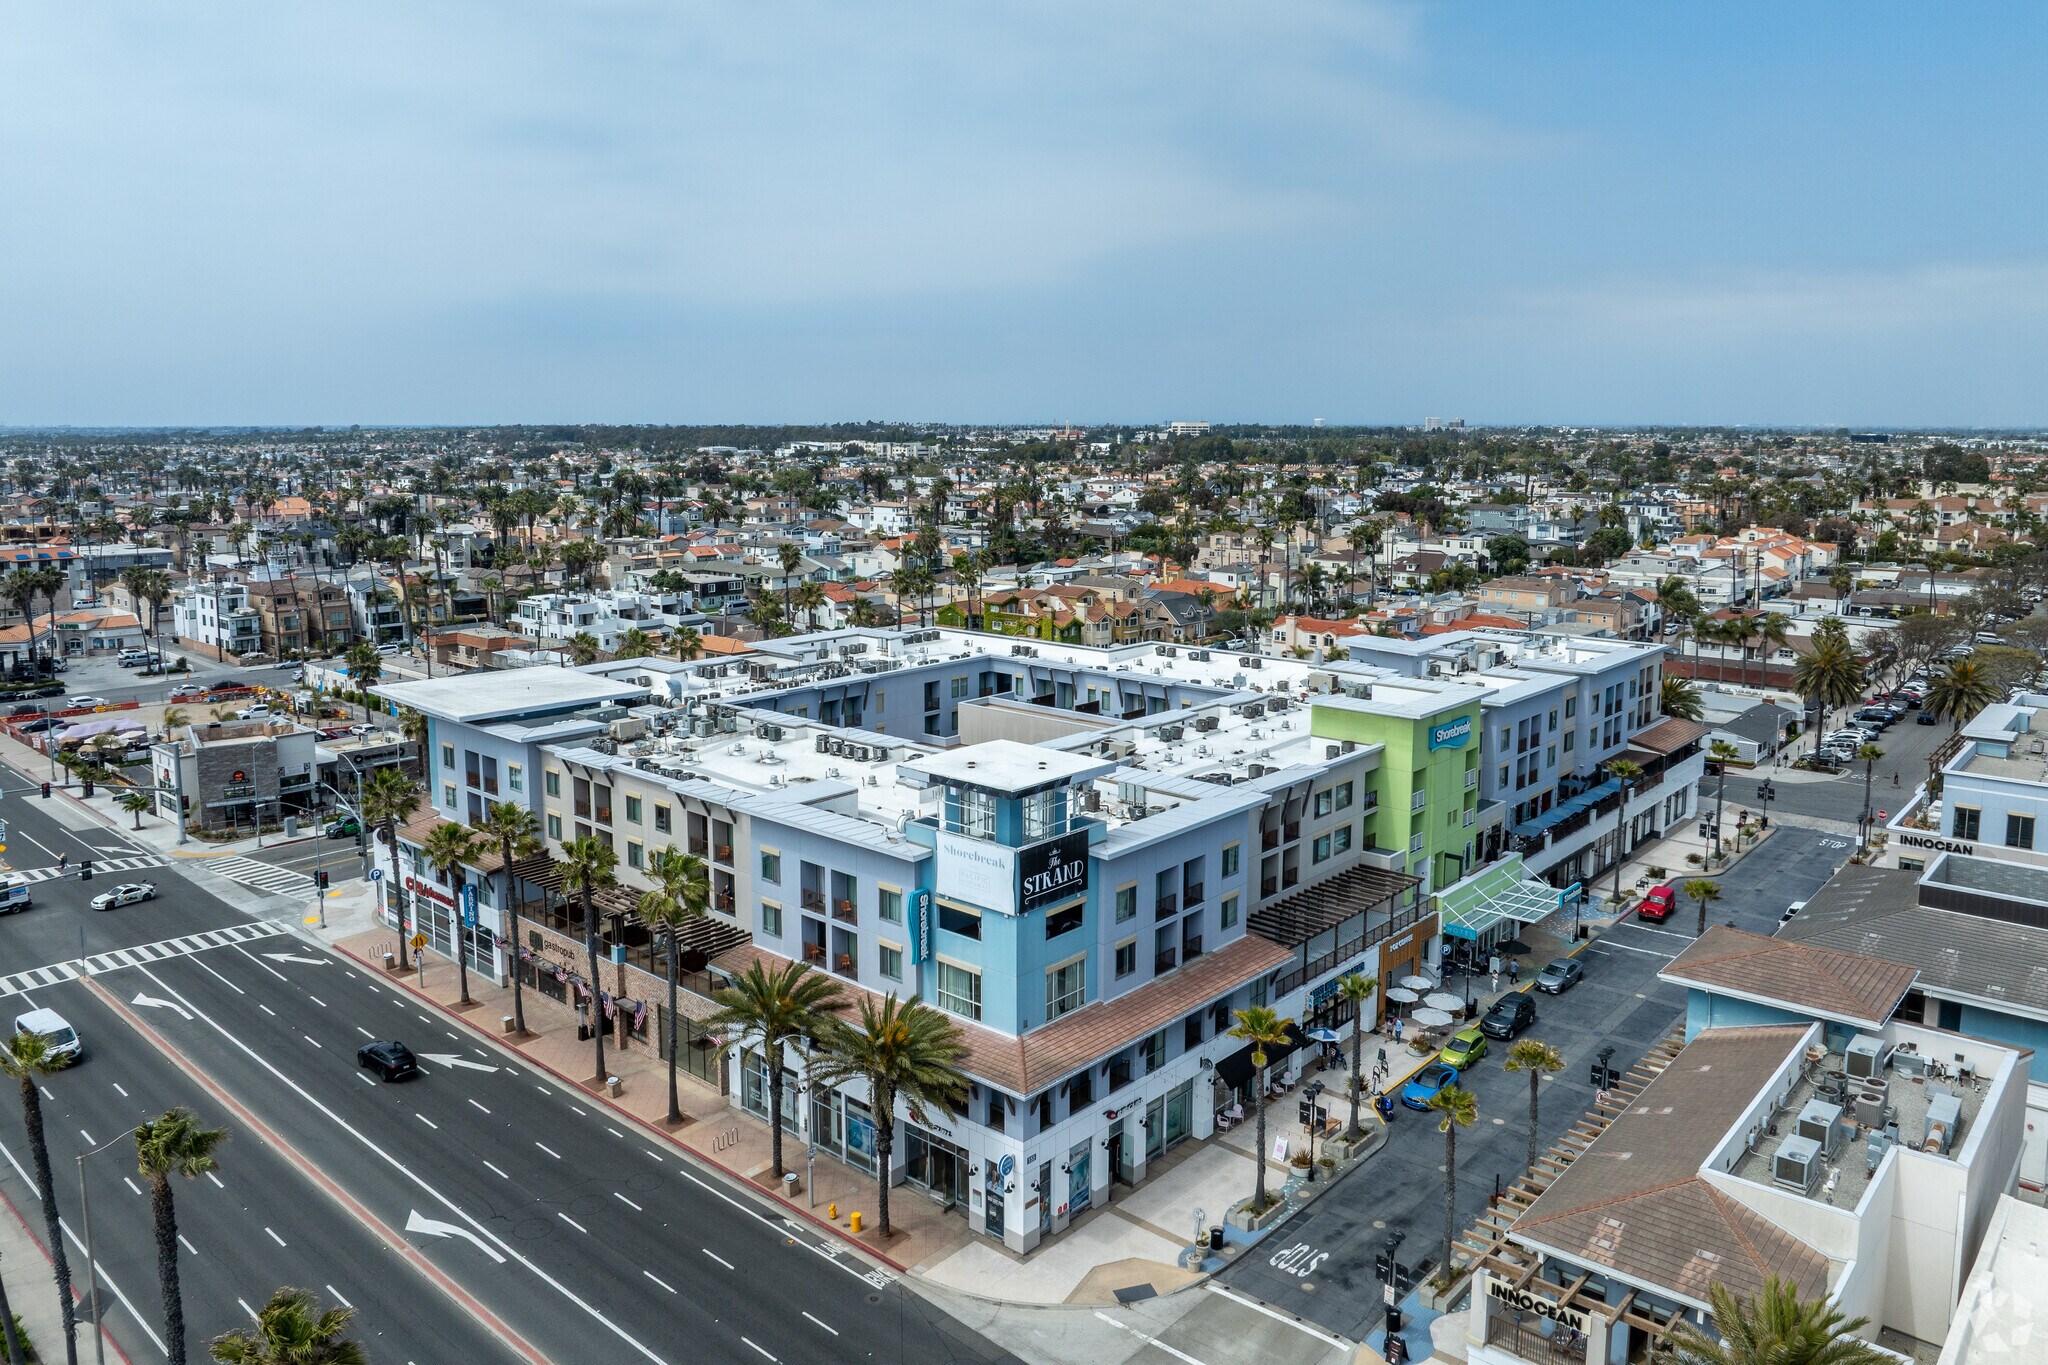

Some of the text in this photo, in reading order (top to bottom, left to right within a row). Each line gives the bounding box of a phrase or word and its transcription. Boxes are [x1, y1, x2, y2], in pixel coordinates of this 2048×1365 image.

[1435, 720, 1471, 743] Shorebreak
[1851, 773, 1879, 782] SOP
[1818, 838, 1848, 849] STOP
[1899, 834, 1973, 855] INNOCEAN
[943, 844, 1006, 870] Shorebreak
[1048, 856, 1061, 869] The
[373, 870, 380, 879] P
[1023, 860, 1084, 895] STRAND
[920, 894, 929, 961] Shorebreak
[1446, 926, 1475, 937] HOTEL
[544, 939, 575, 960] gastropub
[1269, 1242, 1330, 1278] STOP
[1491, 1282, 1582, 1330] INNOCEAN
